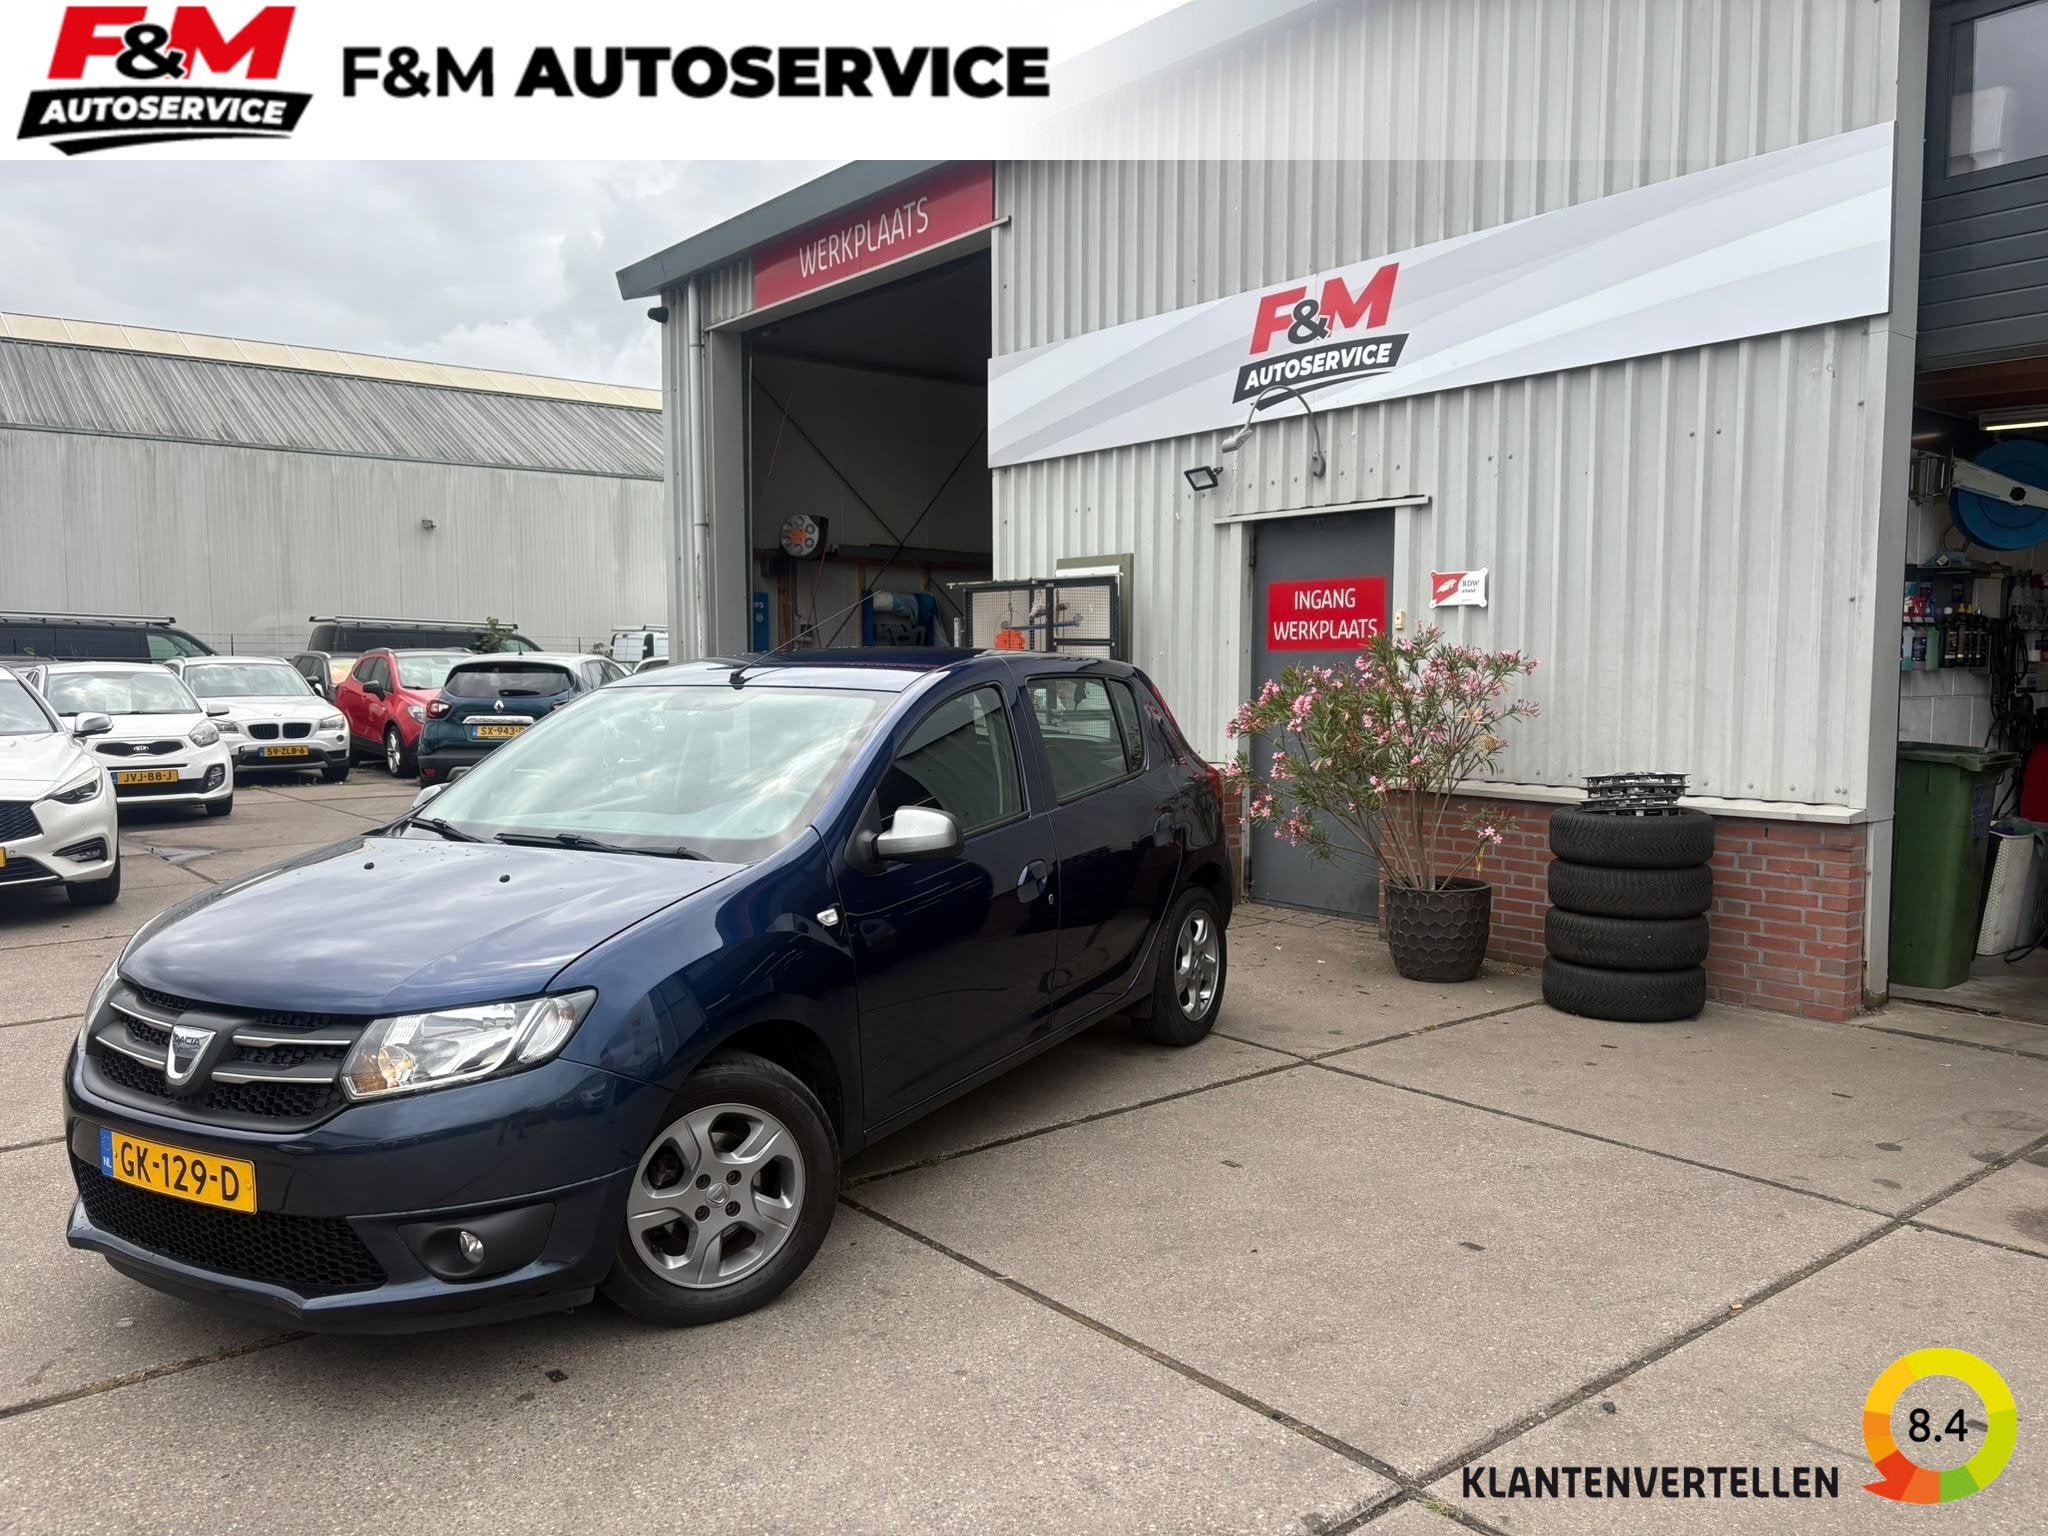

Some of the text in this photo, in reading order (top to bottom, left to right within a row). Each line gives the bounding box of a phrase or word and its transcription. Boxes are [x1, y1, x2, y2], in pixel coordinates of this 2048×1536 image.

[799, 197, 929, 278] WERKPLAATS
[1249, 262, 1400, 356] F&M
[1244, 343, 1393, 391] AUTOSERVICE
[1294, 588, 1356, 610] INGANG
[1273, 618, 1378, 641] WERKPLAATS
[173, 1034, 200, 1046] DACIA
[120, 1141, 240, 1202] GK-129-D
